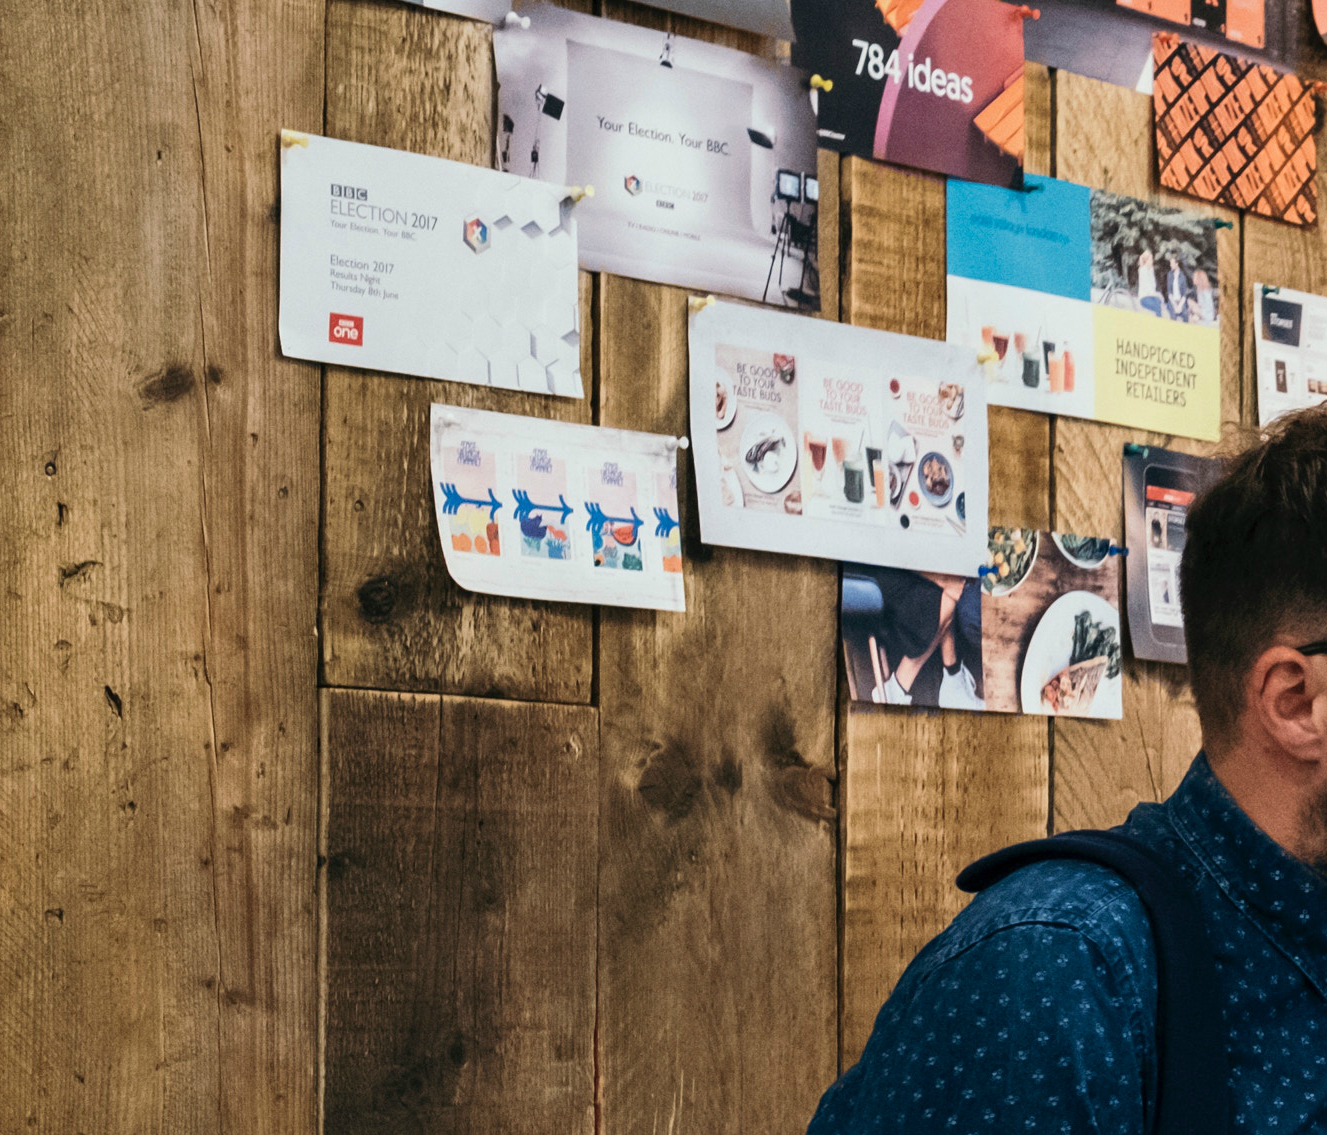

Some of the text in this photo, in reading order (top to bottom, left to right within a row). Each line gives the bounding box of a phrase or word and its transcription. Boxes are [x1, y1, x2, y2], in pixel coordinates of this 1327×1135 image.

[852, 38, 974, 103] 784 ideas
[597, 115, 624, 133] Your
[628, 122, 674, 143] Election.
[679, 132, 703, 149] Your
[331, 184, 368, 201] BBC
[645, 181, 690, 199] ELECTION
[331, 199, 438, 231] ELECTION 2017
[331, 220, 347, 230] Your
[383, 229, 398, 238] Your
[330, 254, 395, 274] Election 2017
[330, 269, 380, 286] Results Night
[331, 281, 399, 300] Thursday 8th June
[333, 325, 359, 340] one
[1116, 338, 1196, 370] HANDPICKED
[737, 363, 778, 379] BE GOOD
[1115, 358, 1197, 390] INDEPENDENT
[740, 374, 775, 390] TO YOUR
[823, 378, 864, 392] BE GOOD
[733, 385, 782, 403] TASTE BUDS
[1126, 380, 1187, 408] RETAILERS
[820, 399, 868, 416] TASTE BUDS
[904, 413, 925, 426] TASTE
